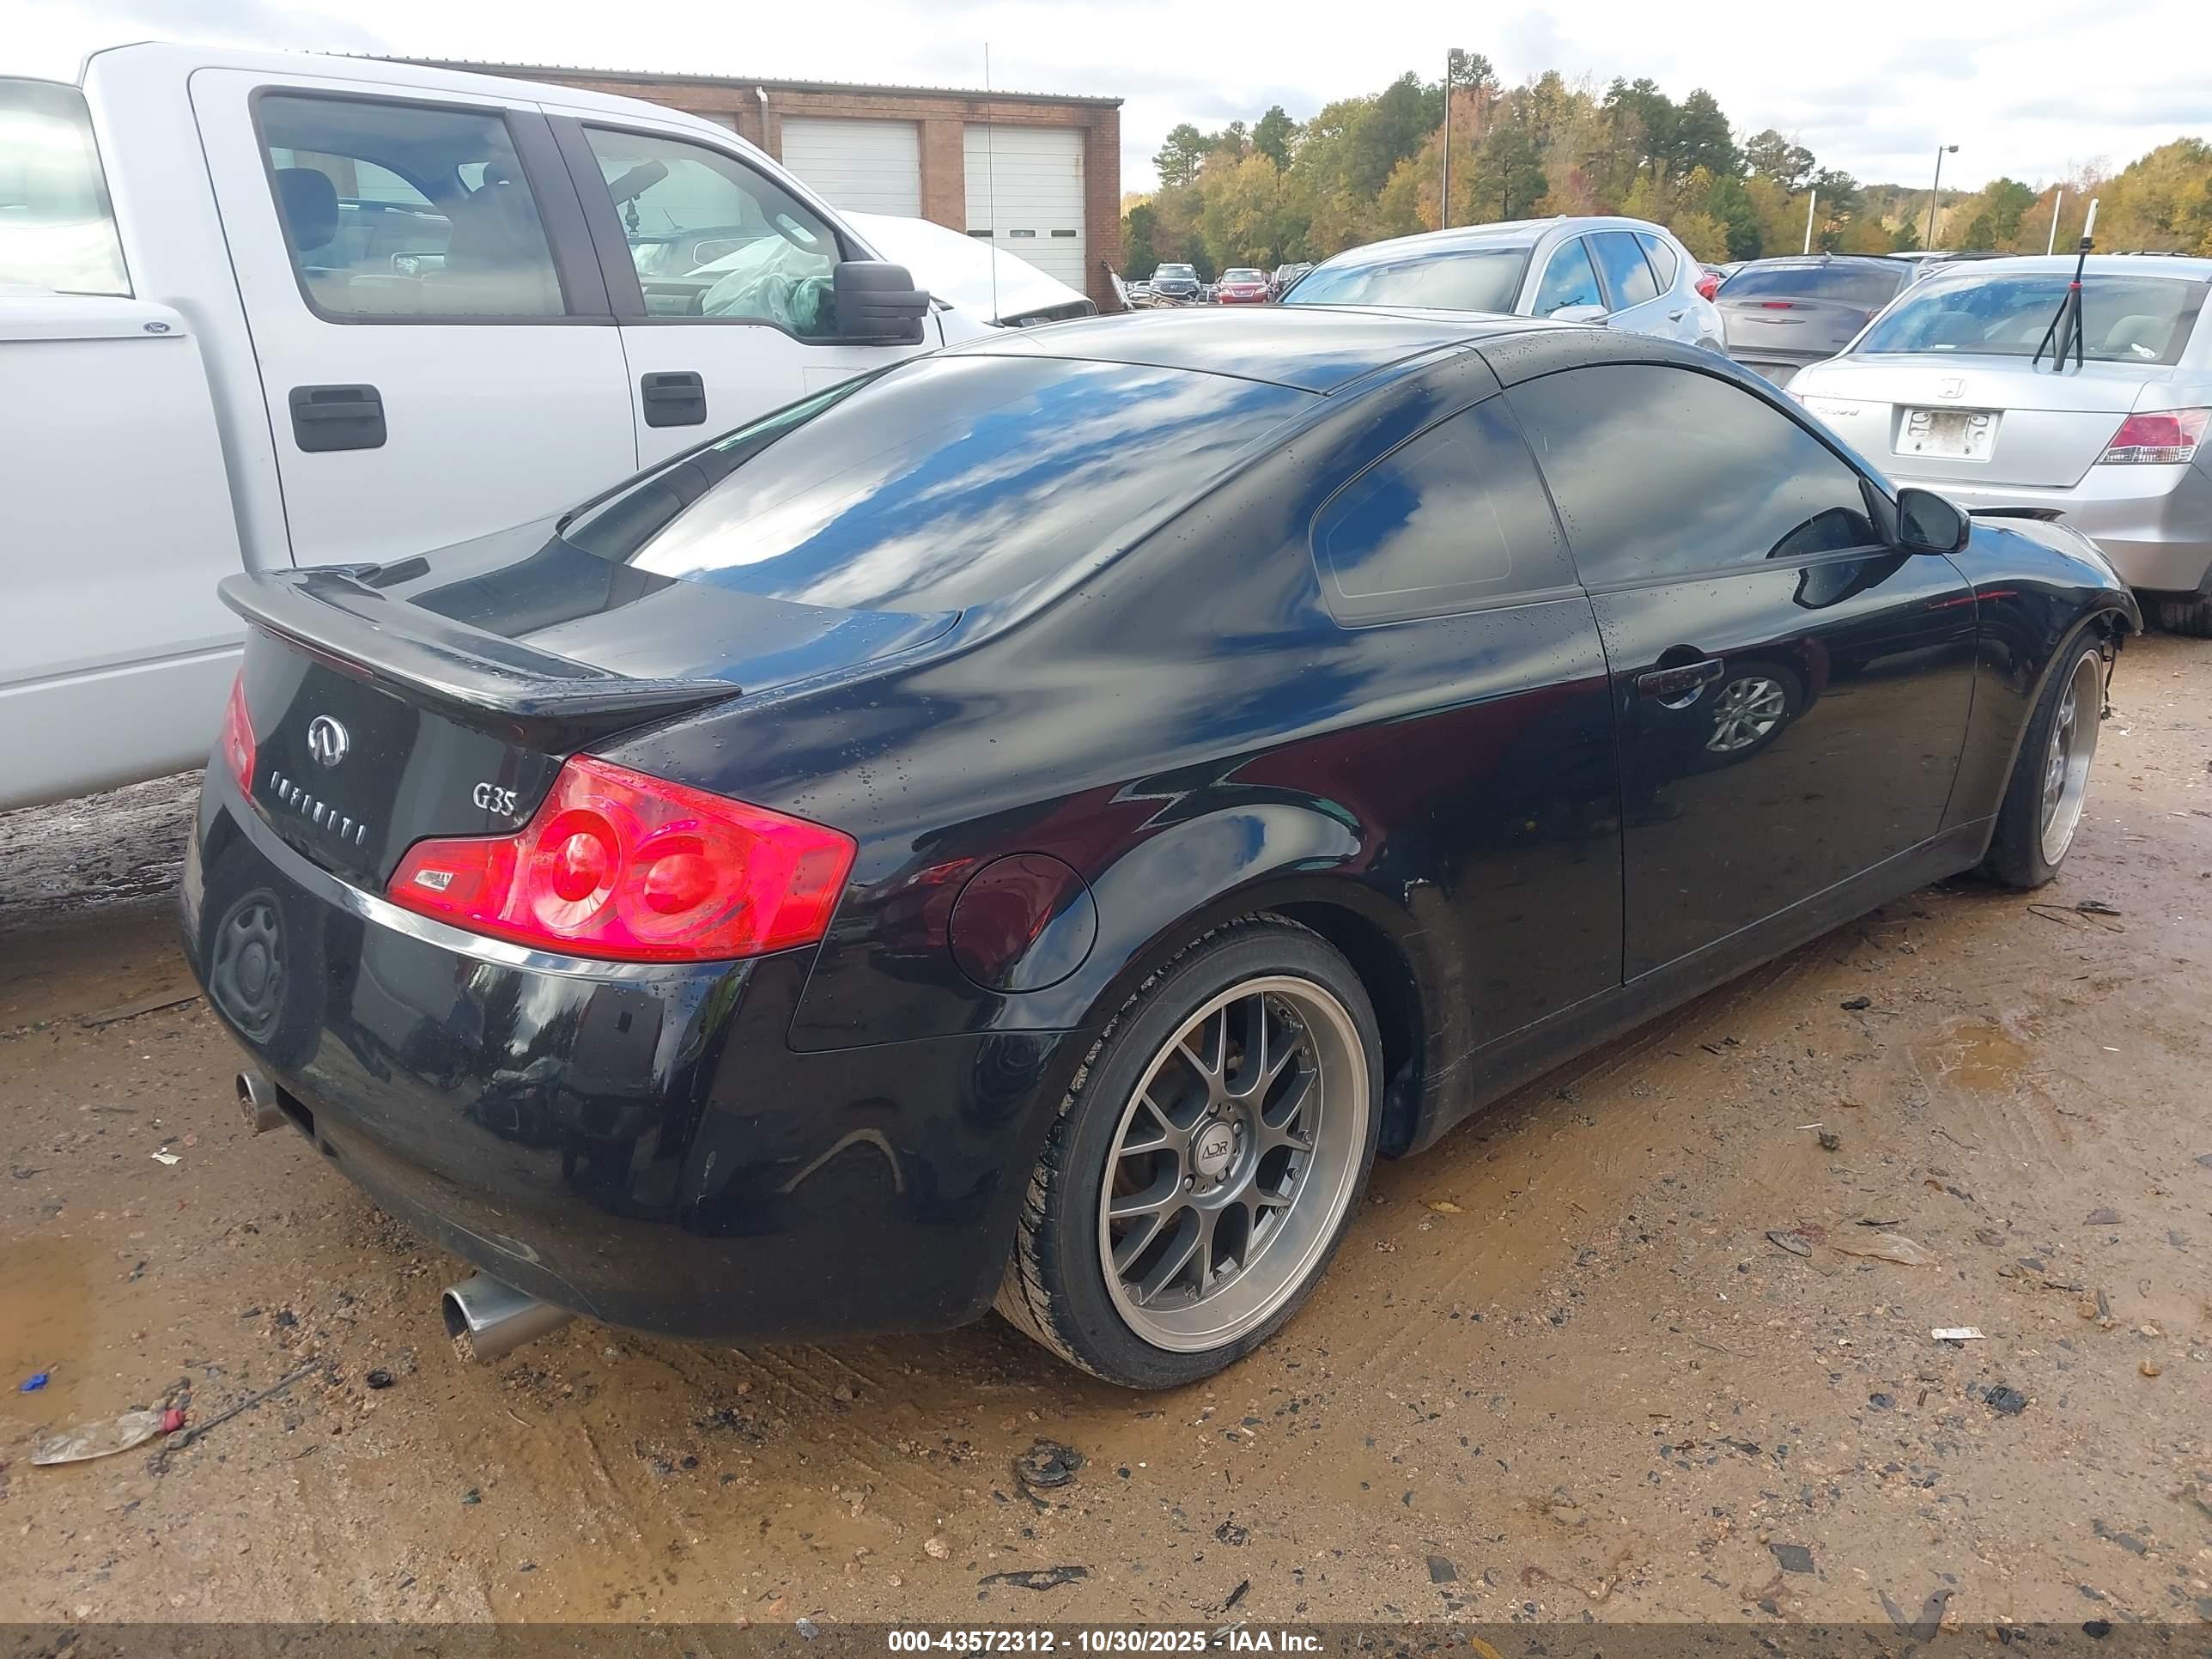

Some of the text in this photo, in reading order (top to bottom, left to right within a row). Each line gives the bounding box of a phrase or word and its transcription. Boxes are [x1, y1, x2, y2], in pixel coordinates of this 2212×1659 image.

[270, 770, 367, 846] INFINITI
[472, 782, 519, 817] G35
[1202, 1140, 1228, 1160] ADR
